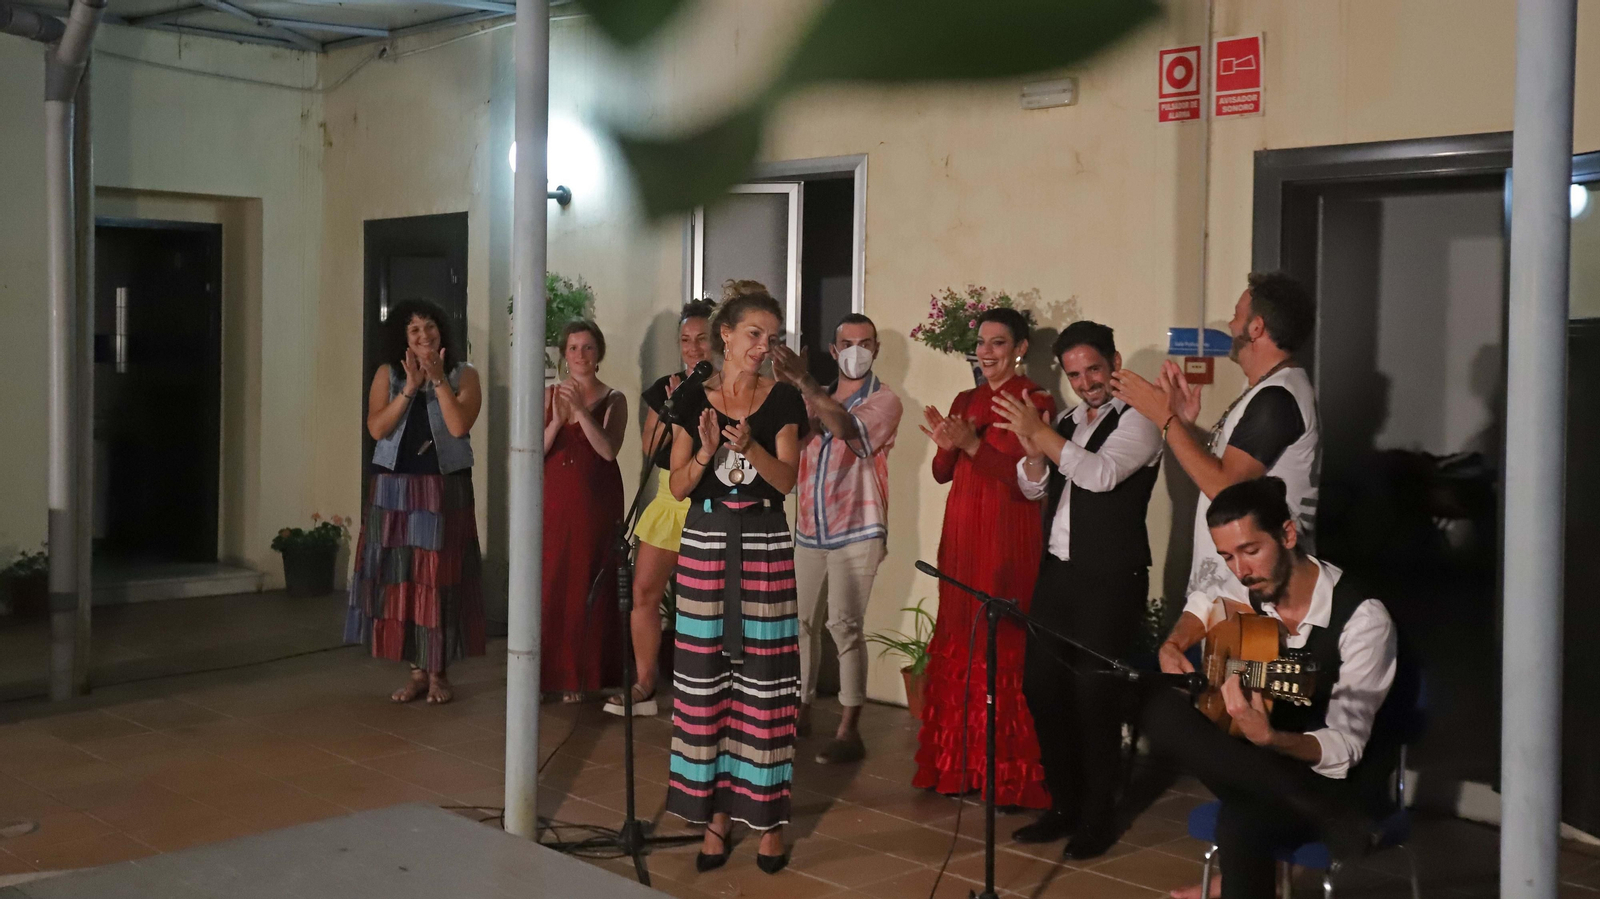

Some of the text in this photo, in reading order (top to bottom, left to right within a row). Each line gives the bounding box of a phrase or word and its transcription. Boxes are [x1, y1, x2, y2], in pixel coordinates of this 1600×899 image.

[1190, 100, 1198, 108] DE
[1219, 95, 1258, 104] AVISADOR
[1222, 103, 1254, 113] SONORO
